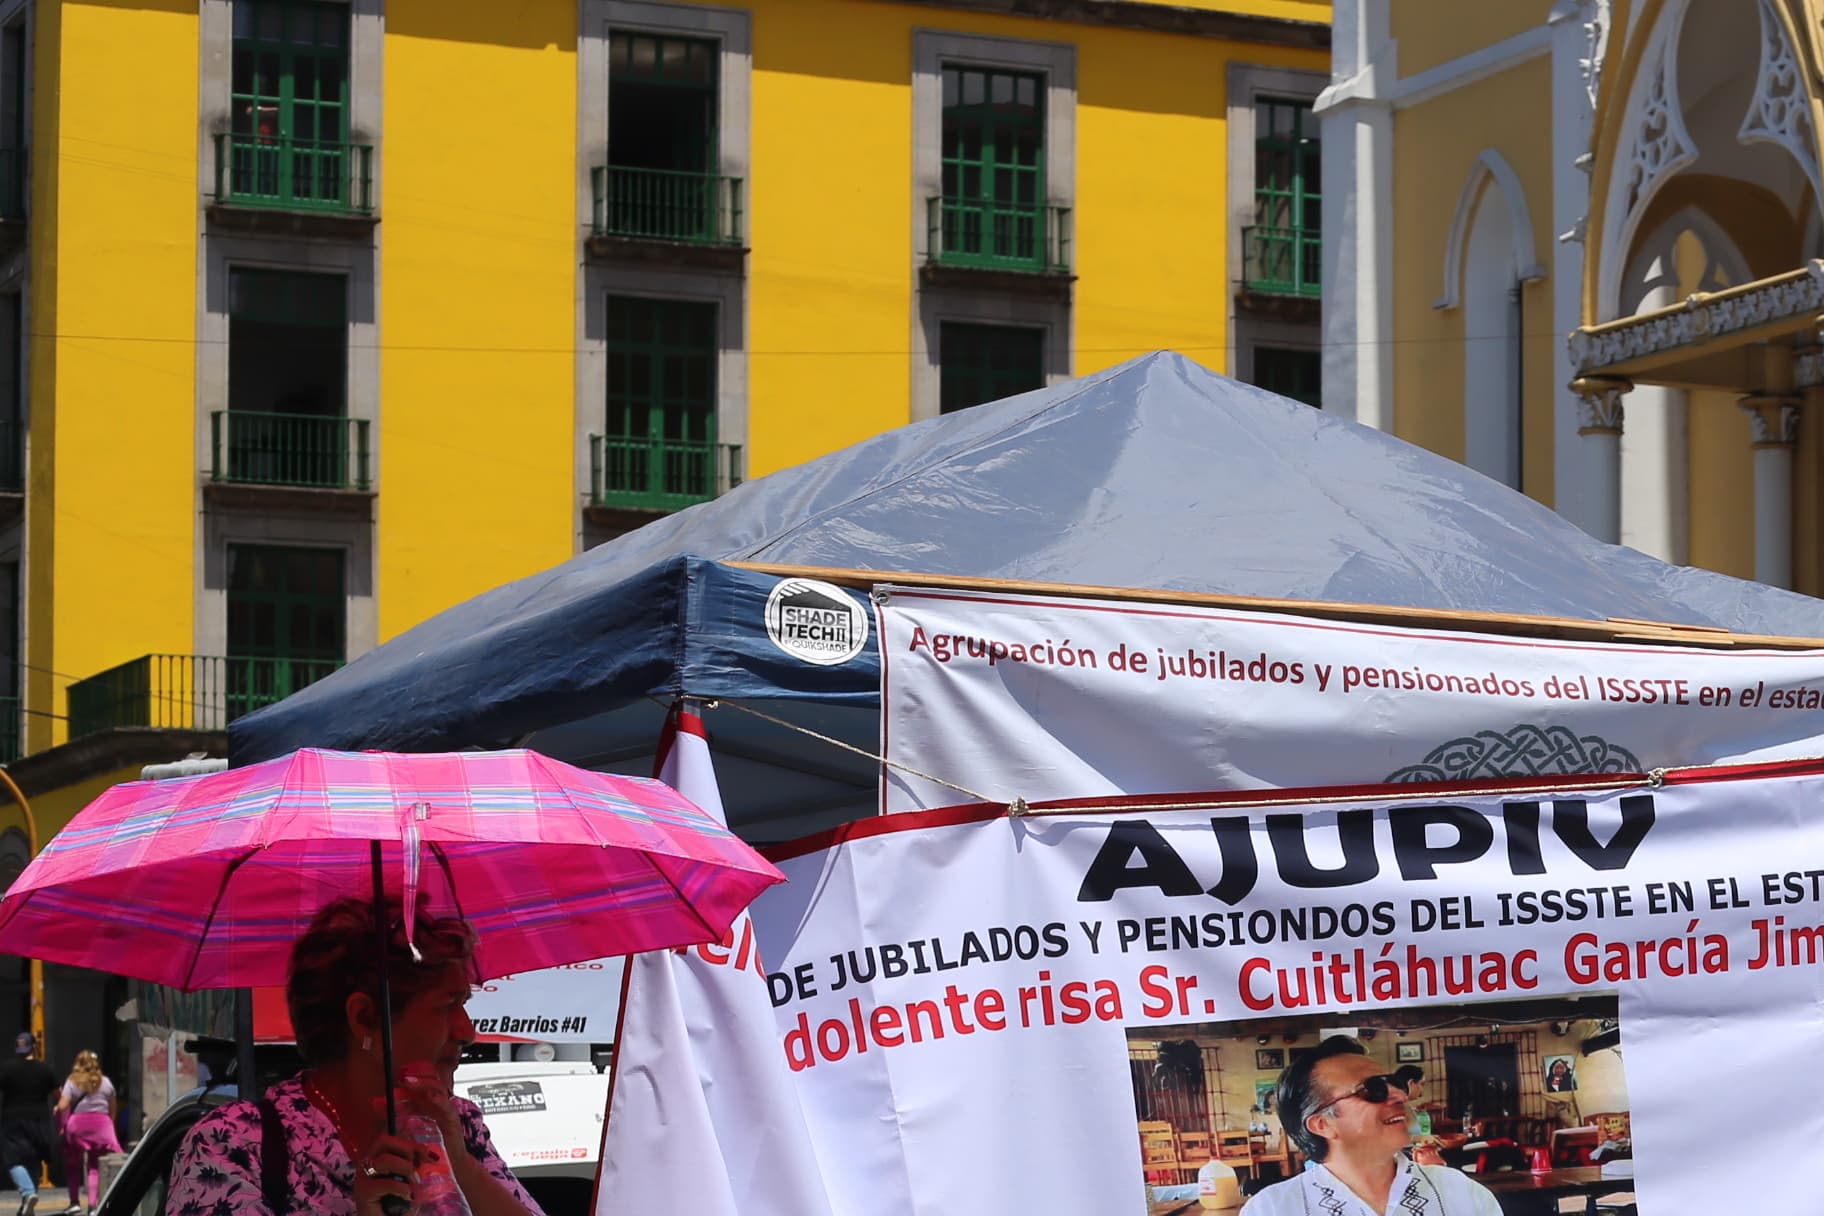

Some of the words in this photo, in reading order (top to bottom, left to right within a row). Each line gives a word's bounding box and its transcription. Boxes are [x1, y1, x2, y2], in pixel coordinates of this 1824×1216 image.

[785, 608, 847, 627] SHADE
[910, 627, 1097, 669] Agrupación
[1108, 644, 1148, 673] de
[1157, 646, 1305, 684] jubilados
[1315, 663, 1332, 692] y
[1343, 665, 1535, 699] pensionados
[1544, 675, 1589, 702] del
[1598, 678, 1690, 706] ISSSTE
[1699, 685, 1732, 709] en
[1739, 681, 1764, 710] el
[1077, 795, 1656, 906] AJUPIV
[766, 962, 818, 1007] DE
[830, 923, 1069, 991] JUBILADOS
[1080, 922, 1102, 954] Y
[1118, 901, 1395, 953] PENSIONDOS
[1411, 896, 1484, 933] DEL
[1497, 886, 1634, 927] ISSSTE
[1645, 881, 1695, 916] EN
[1707, 877, 1750, 911] EL
[500, 1015, 559, 1033] Barrios
[561, 1016, 587, 1033] #41
[784, 984, 1007, 1072] dolente
[1018, 971, 1125, 1028] risa
[1139, 965, 1216, 1019] Sr.
[1239, 943, 1539, 1012] Cuitláhuac
[1564, 920, 1730, 985] García
